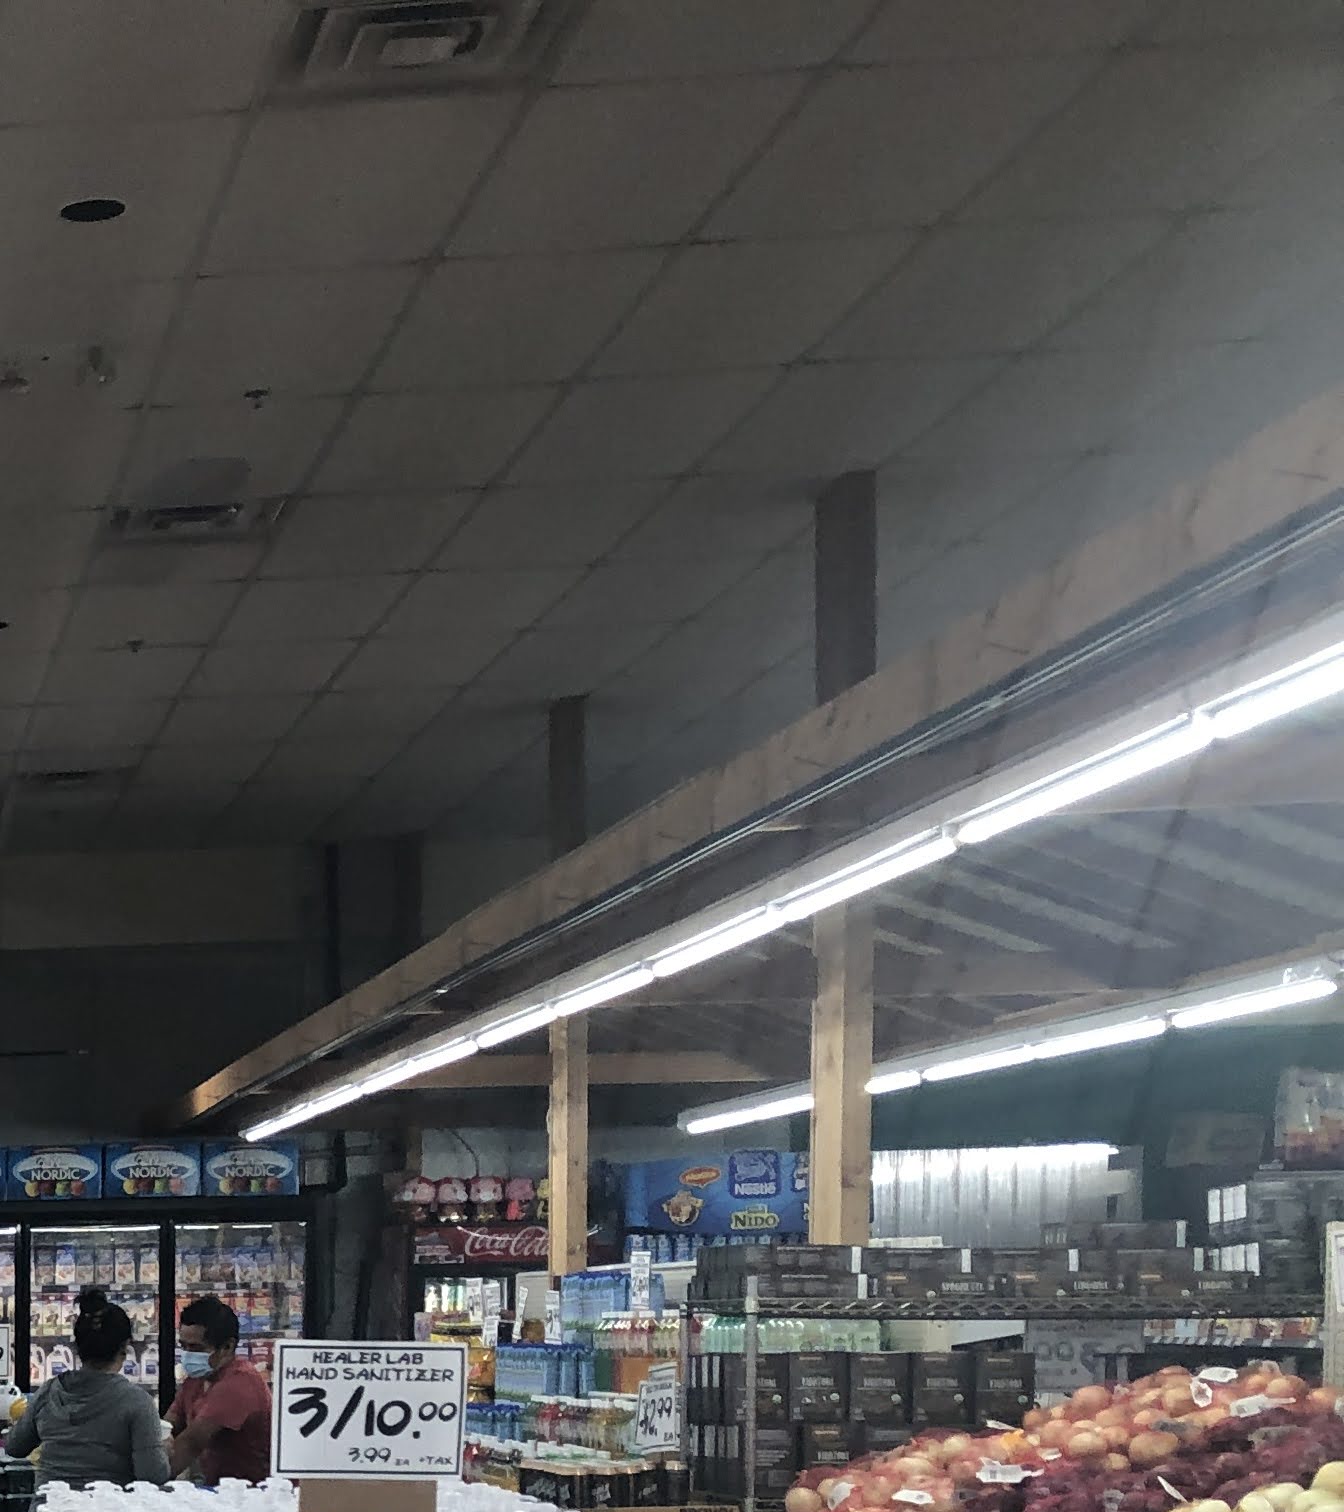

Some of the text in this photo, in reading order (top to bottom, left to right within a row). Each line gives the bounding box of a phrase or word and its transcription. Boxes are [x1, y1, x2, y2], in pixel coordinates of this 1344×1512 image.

[31, 1168, 80, 1180] NORDIC
[129, 1165, 178, 1178] NORDIC
[225, 1165, 275, 1177] NORDIC
[733, 1213, 776, 1228] NIDO
[313, 1351, 423, 1365] HEALER LAB
[286, 1367, 454, 1382] HAND SANITIZER
[288, 1385, 458, 1439] 3/10.00
[348, 1447, 391, 1464] 3.99
